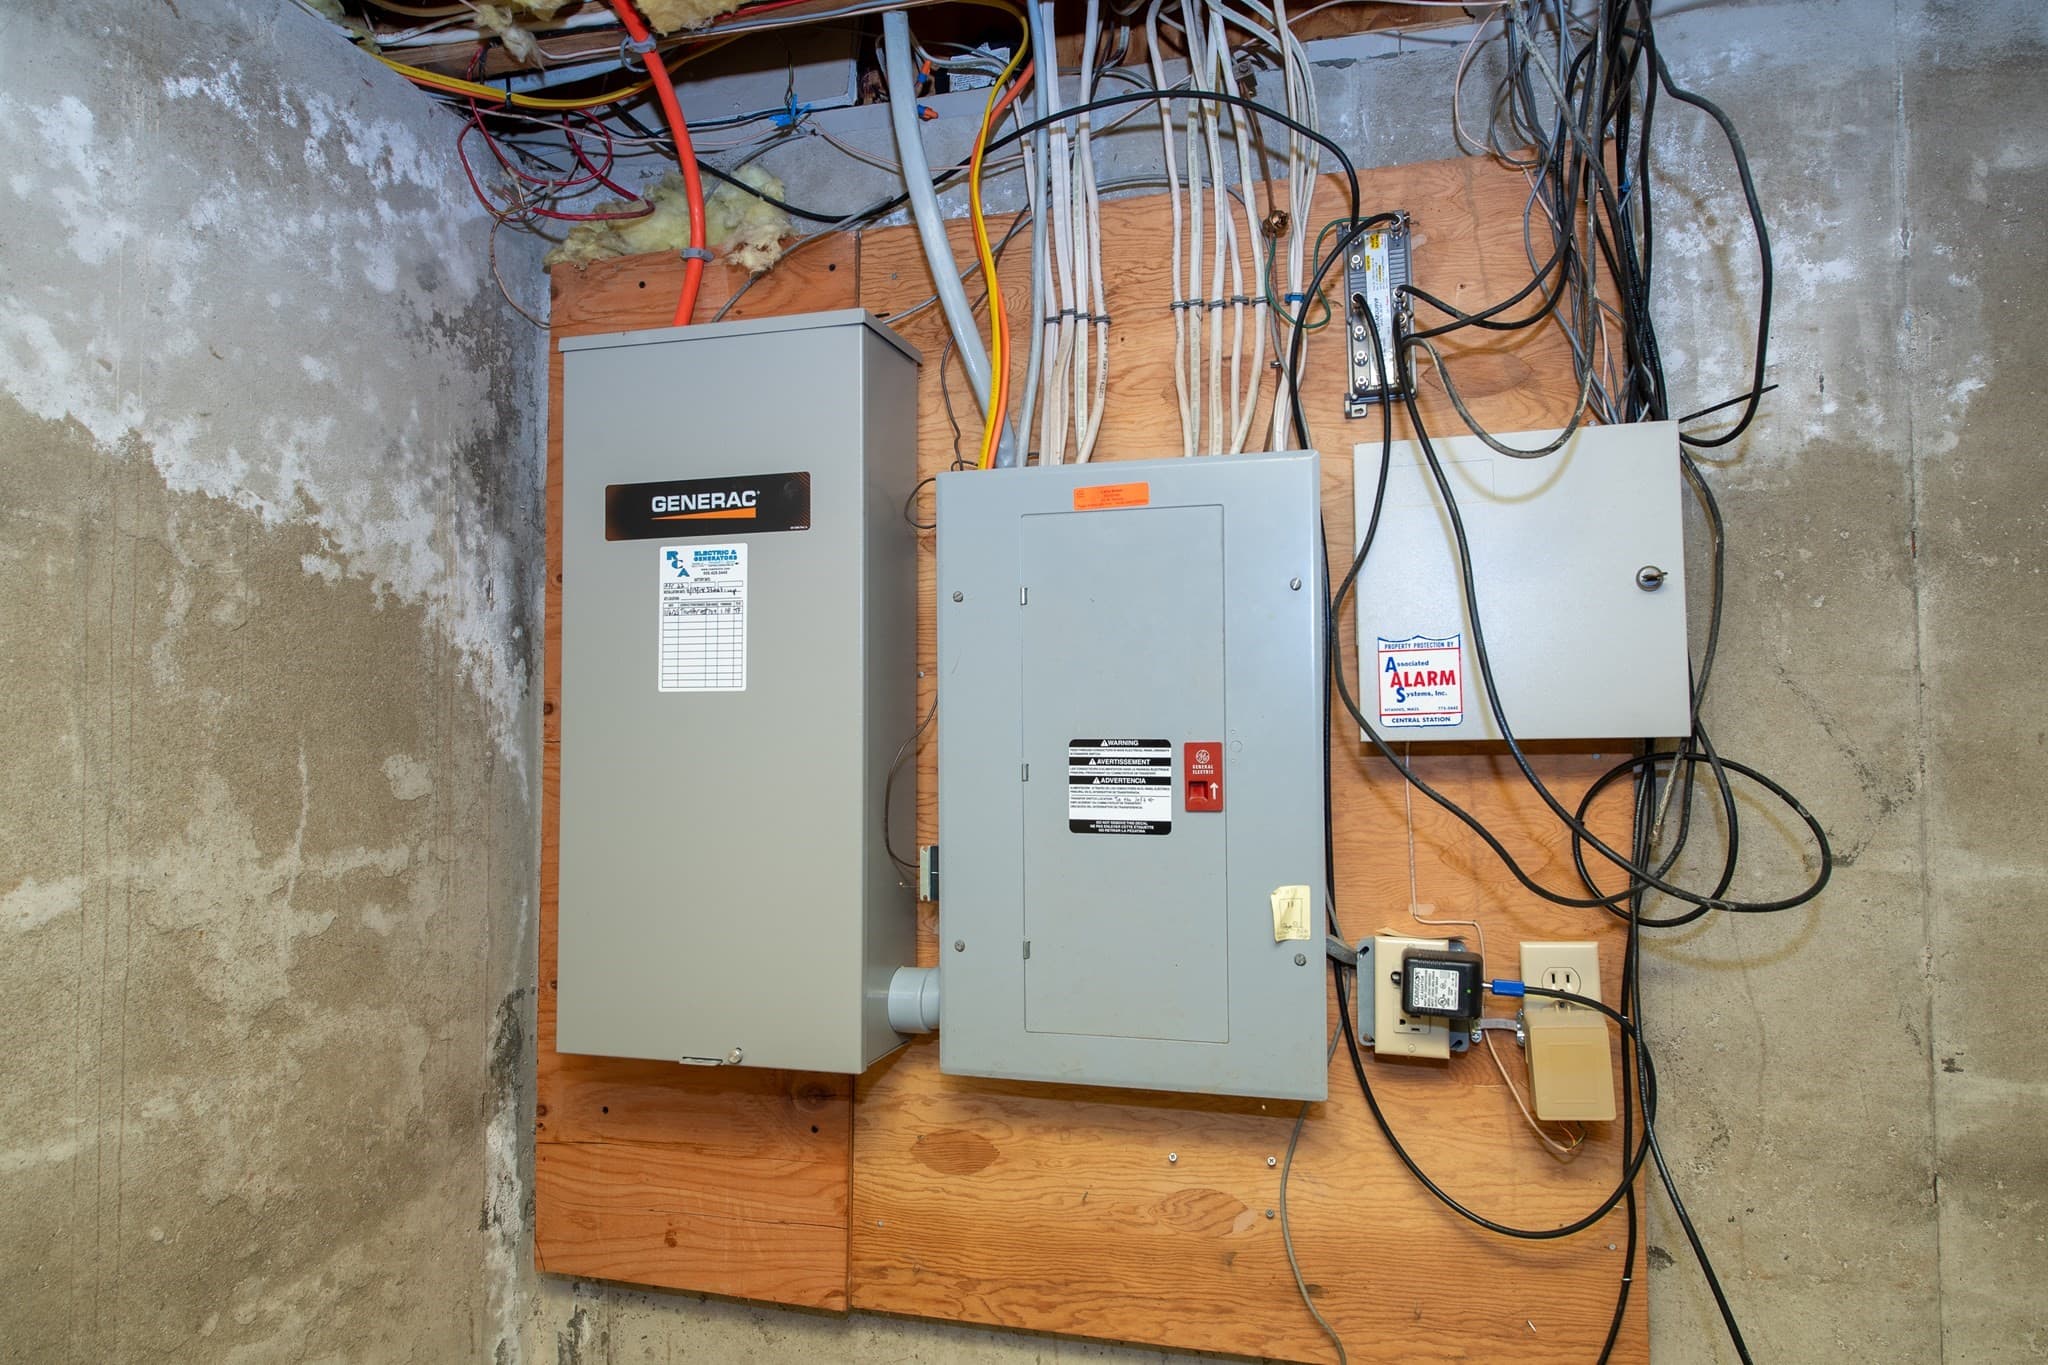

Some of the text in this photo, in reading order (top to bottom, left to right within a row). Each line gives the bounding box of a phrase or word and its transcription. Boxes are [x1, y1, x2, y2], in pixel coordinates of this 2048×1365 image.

[652, 490, 757, 512] GENERAC
[1385, 656, 1429, 672] Associated
[1390, 670, 1456, 688] ALARM
